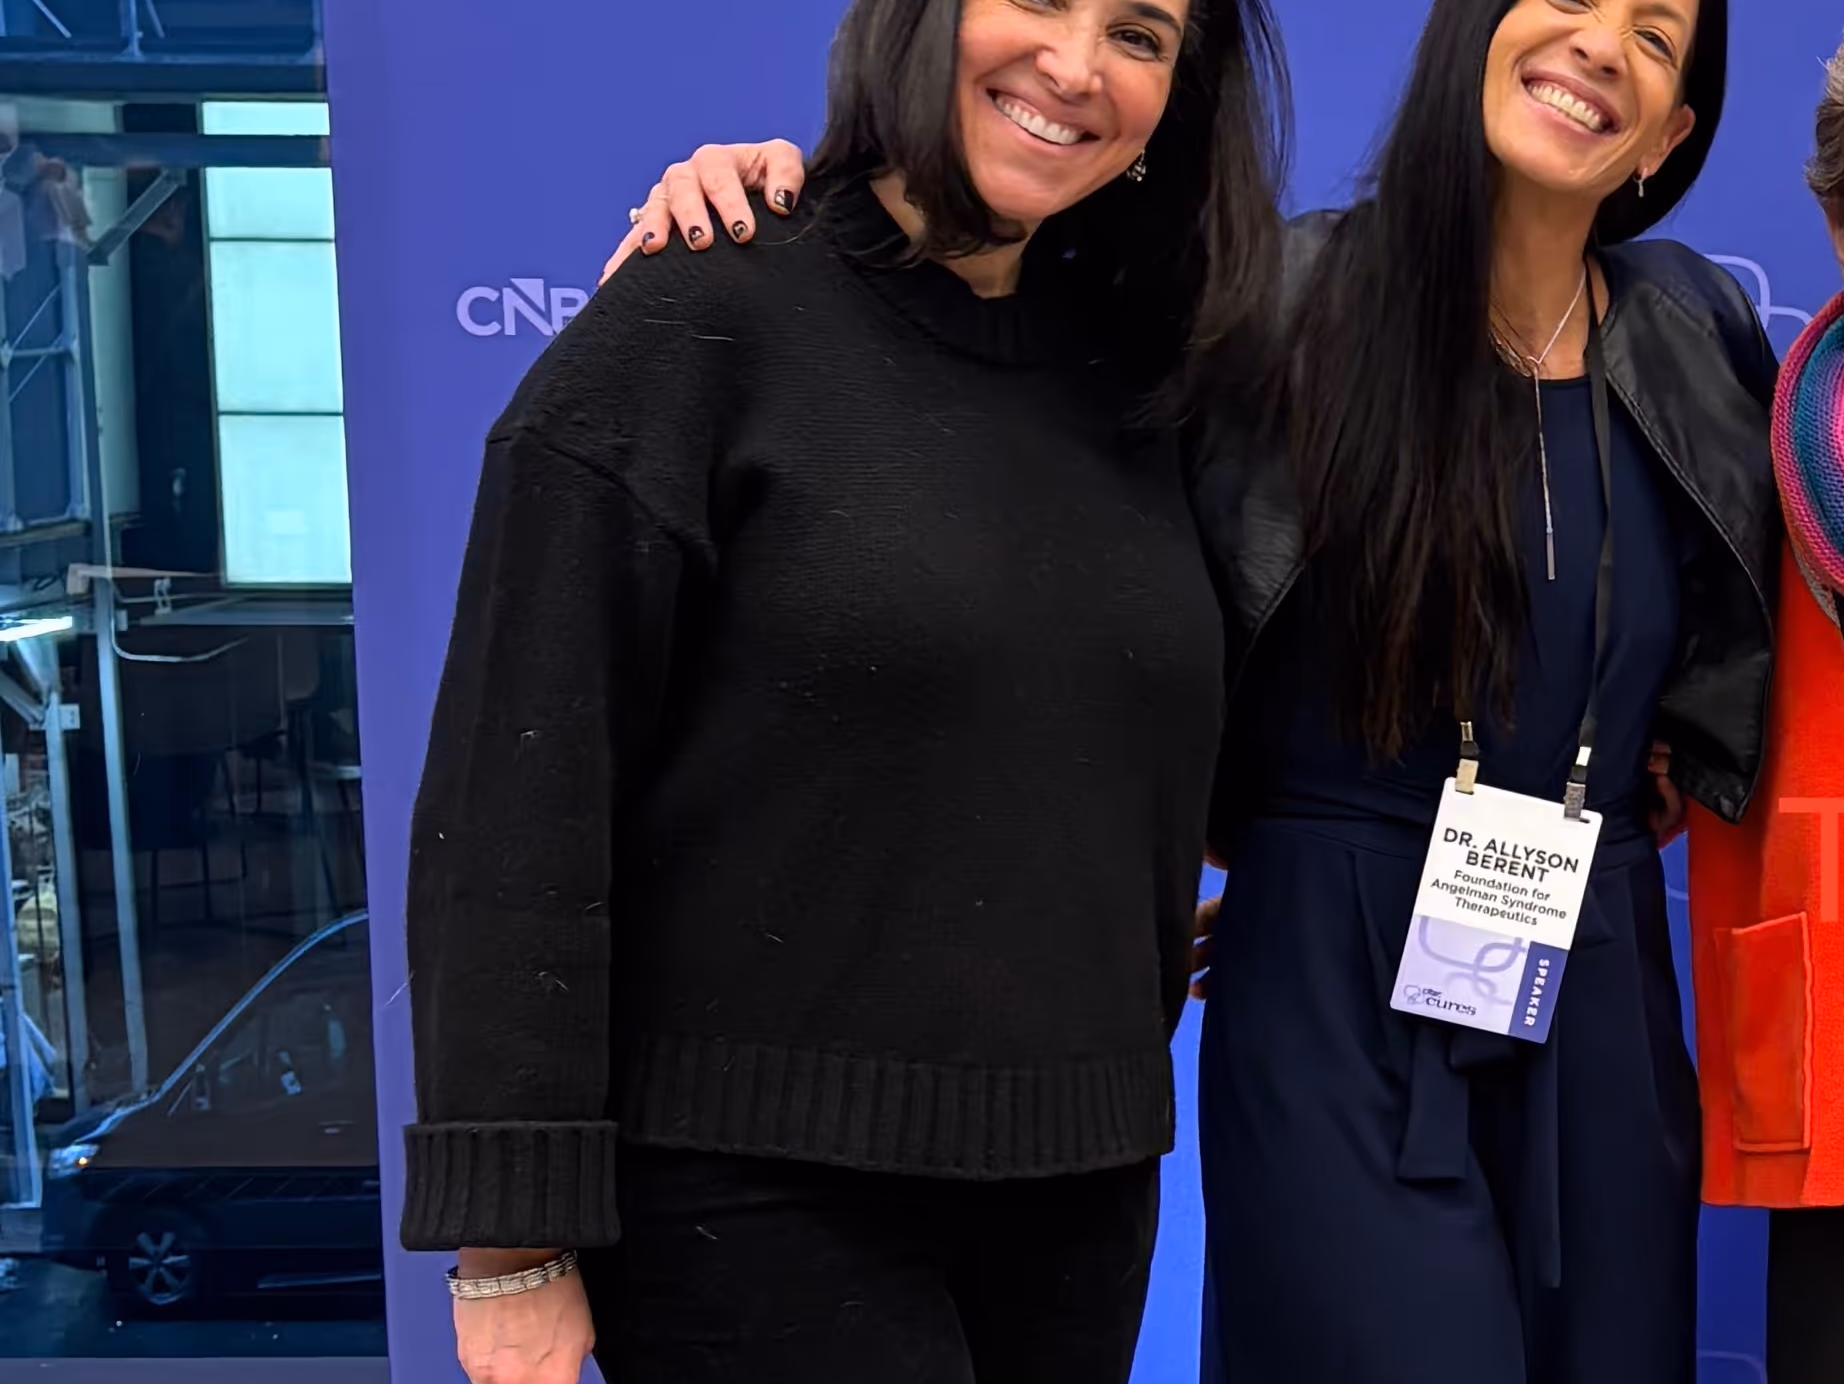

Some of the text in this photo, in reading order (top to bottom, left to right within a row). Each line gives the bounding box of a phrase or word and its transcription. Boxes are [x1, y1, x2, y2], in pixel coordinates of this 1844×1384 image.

[456, 278, 590, 336] CNB
[1443, 828, 1579, 873] DR. ALLYSON
[1466, 851, 1550, 883] BERENT
[1431, 878, 1567, 919] Angelman Syndrome
[1454, 870, 1551, 902] Foundation for
[1455, 897, 1538, 926] Therapeutics
[1523, 959, 1550, 1027] SPEAKER
